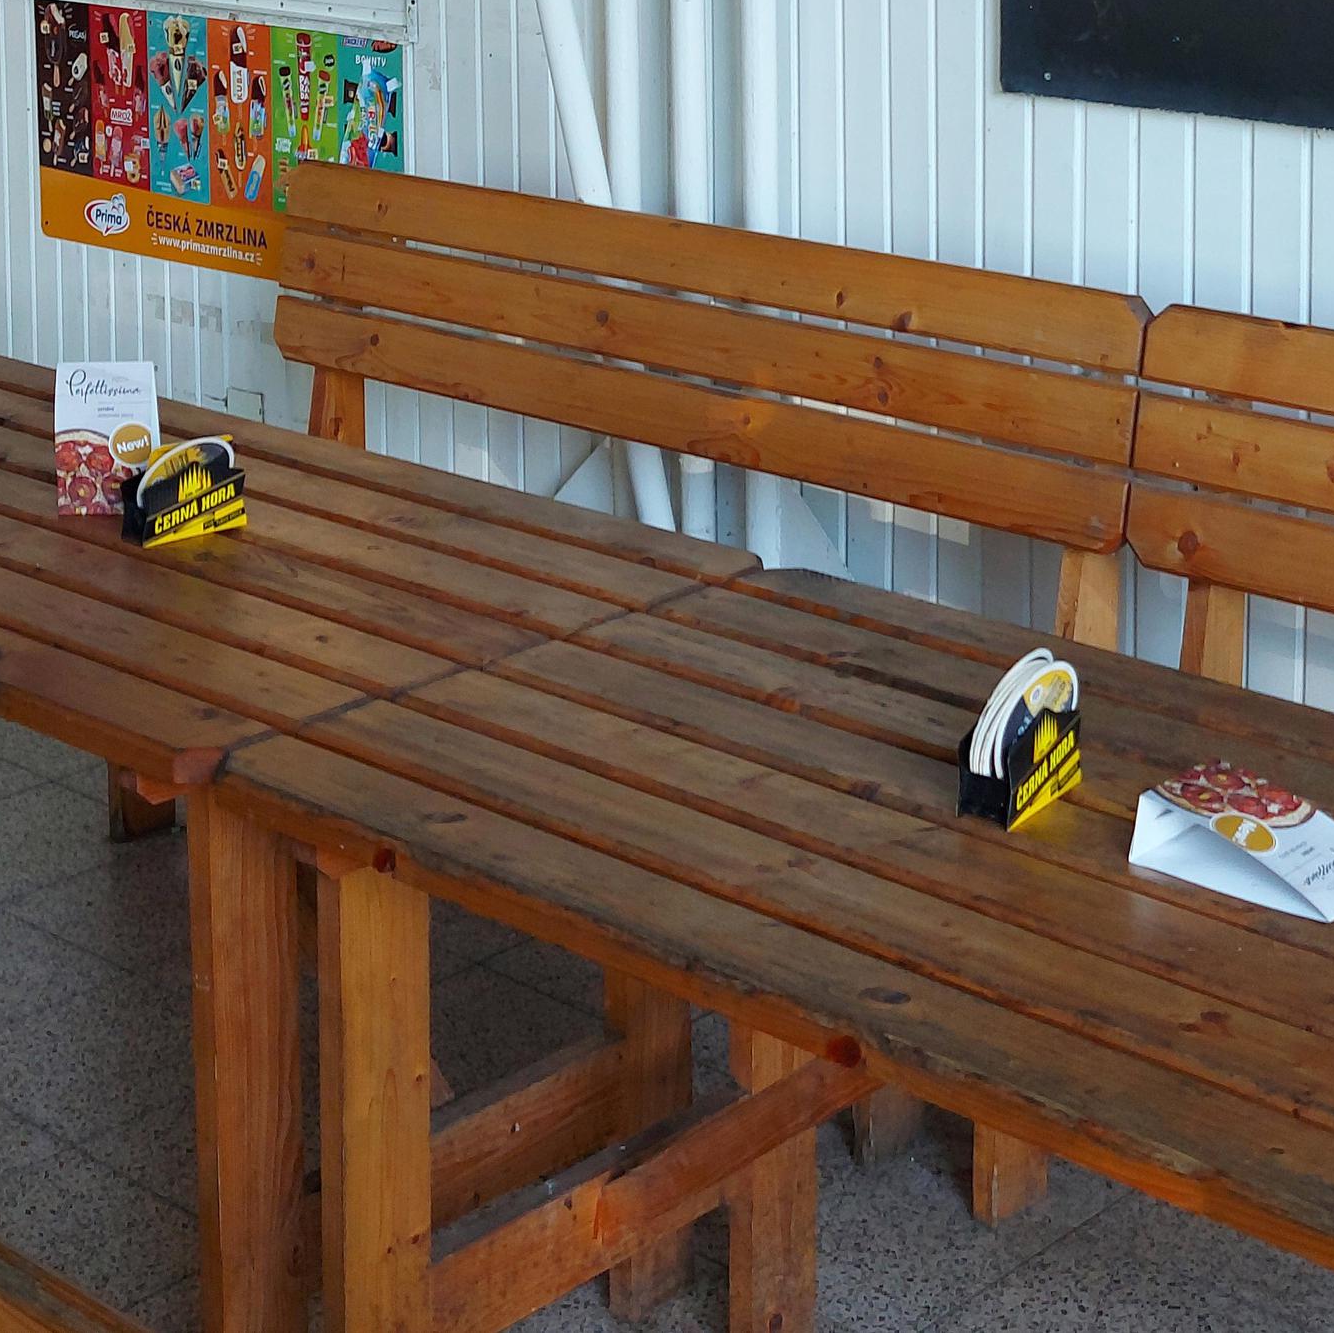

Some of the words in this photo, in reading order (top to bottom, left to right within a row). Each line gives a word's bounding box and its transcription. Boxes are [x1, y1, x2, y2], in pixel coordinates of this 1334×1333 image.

[95, 209, 122, 226] Prima
[146, 205, 191, 236] ČESKÁ
[195, 219, 268, 250] ZMRZLINA
[158, 234, 255, 263] www.primazmrzlina.cz
[116, 435, 149, 454] New!
[201, 482, 235, 512] HORA
[1049, 730, 1075, 773] HORA
